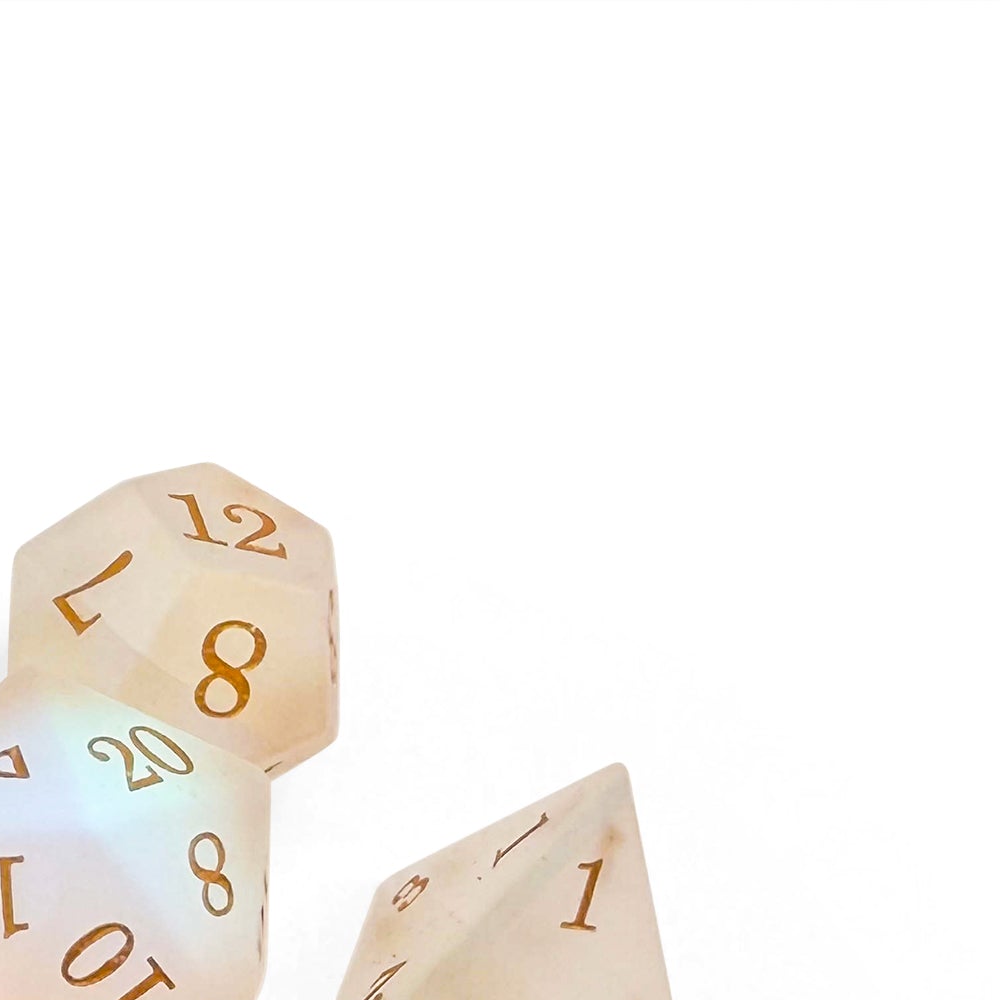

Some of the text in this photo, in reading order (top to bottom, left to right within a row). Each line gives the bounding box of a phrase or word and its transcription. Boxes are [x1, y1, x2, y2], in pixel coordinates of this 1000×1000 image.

[168, 493, 287, 560] 12
[52, 550, 133, 636] 7
[195, 619, 267, 718] 8
[87, 726, 194, 792] 20
[188, 832, 234, 917] 8
[493, 812, 550, 868] 1
[560, 858, 603, 932] 1
